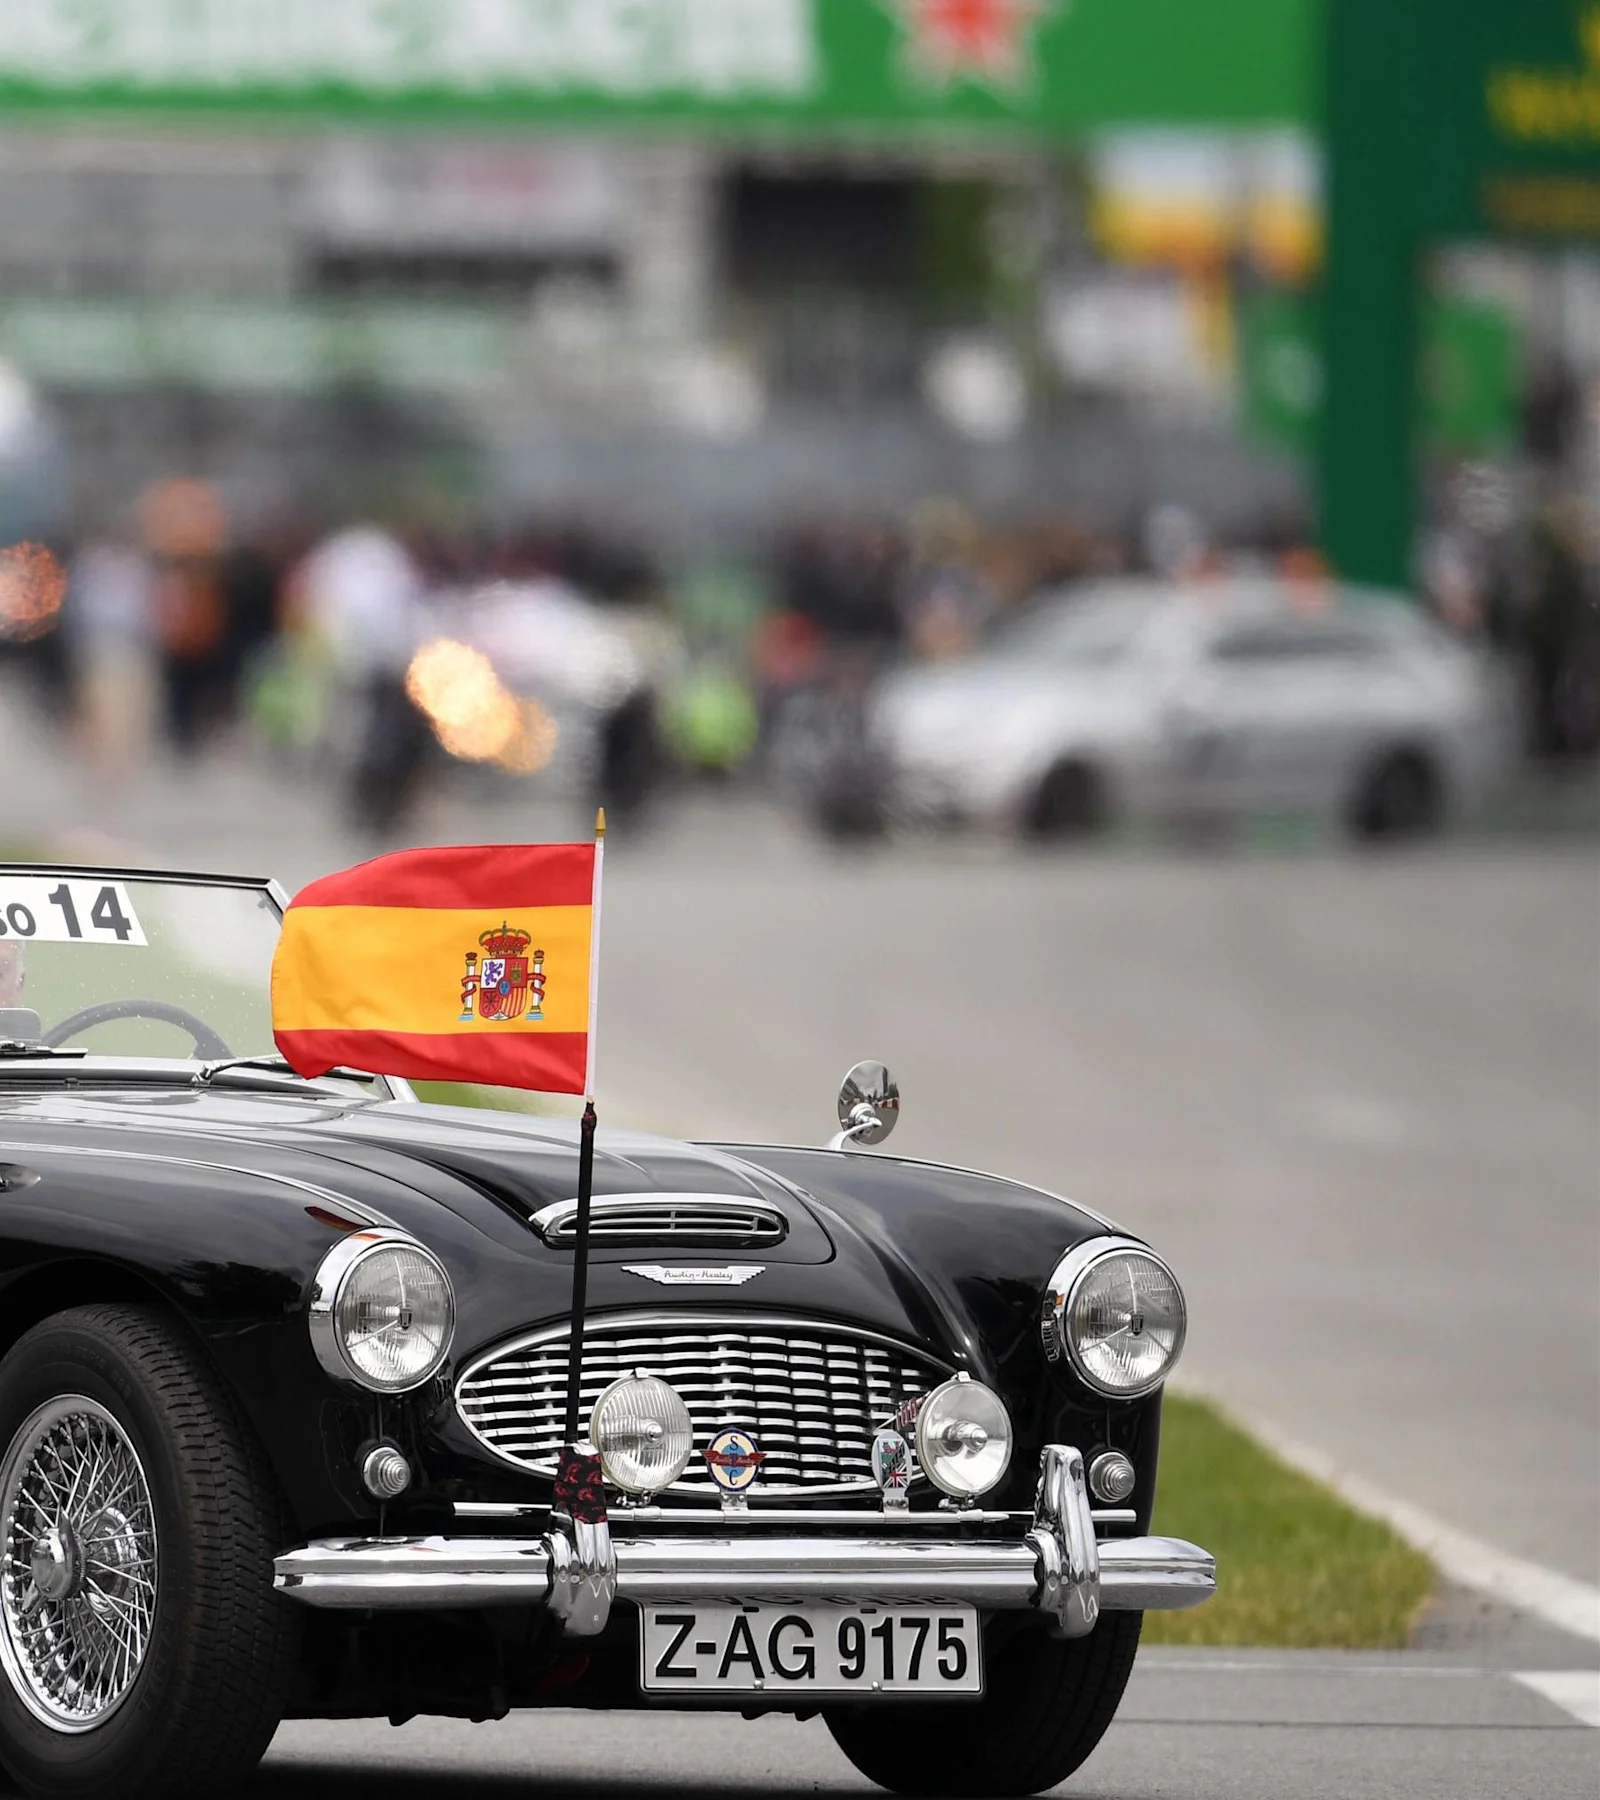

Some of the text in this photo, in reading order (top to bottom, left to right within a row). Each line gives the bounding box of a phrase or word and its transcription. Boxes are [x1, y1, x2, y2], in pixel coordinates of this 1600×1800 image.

[48, 884, 133, 941] 14
[729, 1435, 739, 1451] S
[729, 1469, 738, 1486] C
[654, 1614, 968, 1680] Z-AG 9175
